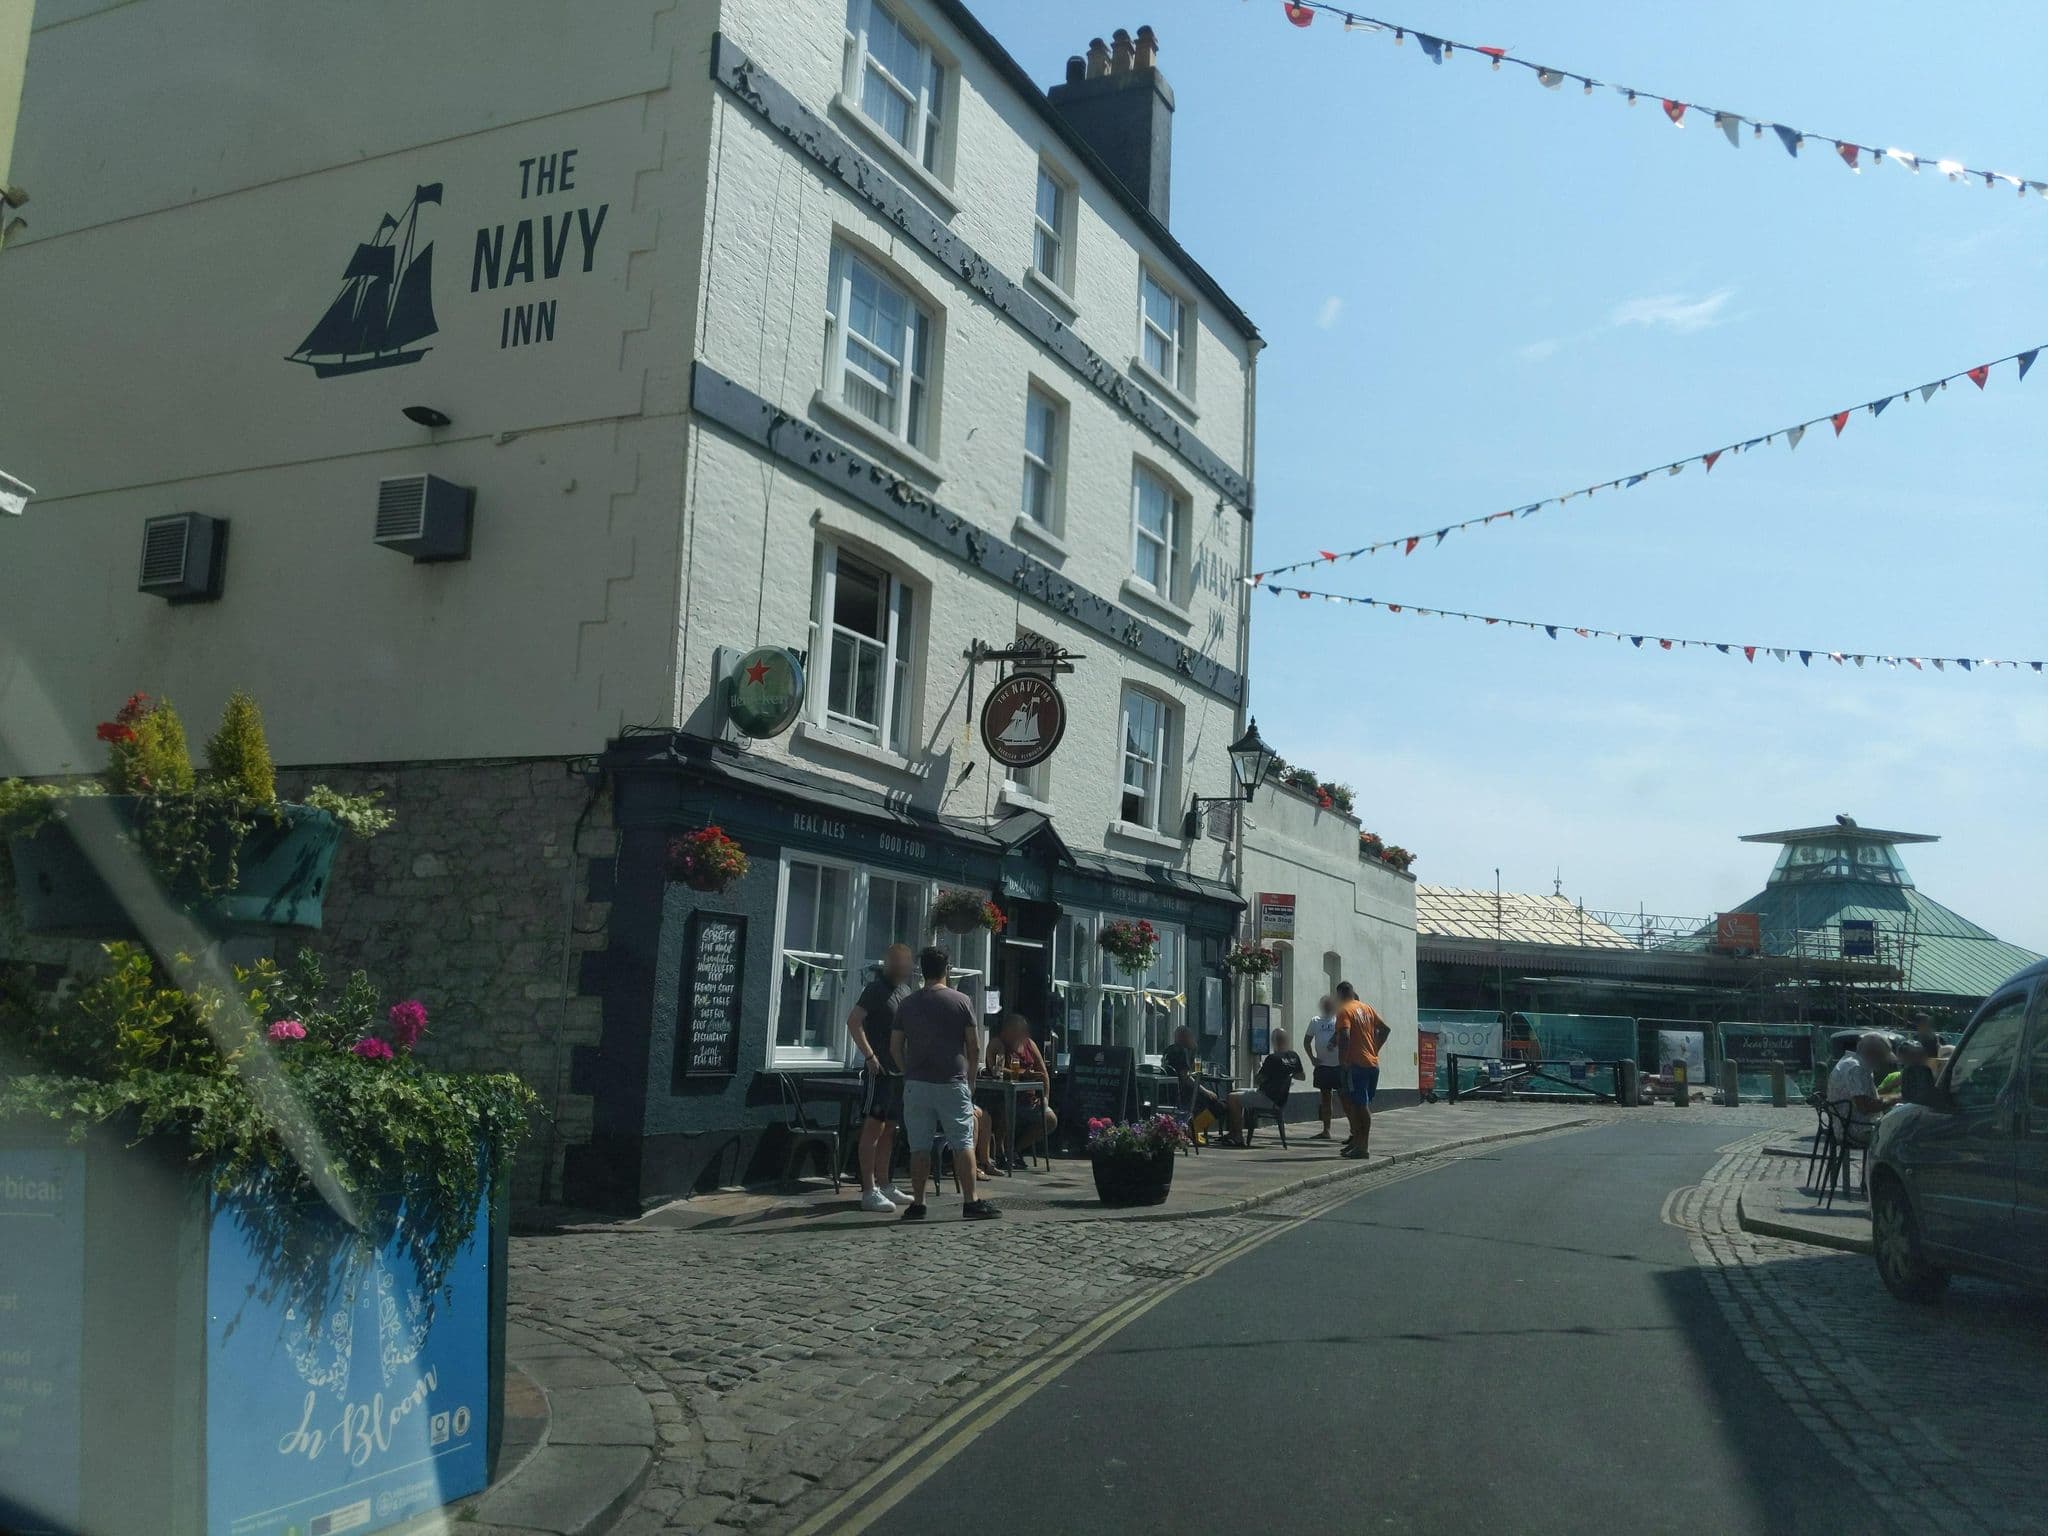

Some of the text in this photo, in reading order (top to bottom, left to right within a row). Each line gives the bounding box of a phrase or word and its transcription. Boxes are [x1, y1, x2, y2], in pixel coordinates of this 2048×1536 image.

[519, 147, 578, 199] THE
[470, 203, 610, 293] NAVY
[500, 299, 557, 349] INN
[1198, 542, 1239, 607] NAVY
[998, 690, 1010, 704] THE
[1011, 681, 1041, 694] NAVY
[793, 813, 926, 858] REAL ALES GOOD FOOD
[702, 928, 736, 943] SPORTS
[1277, 916, 1292, 924] Stop
[278, 1364, 438, 1467] In Bloom
